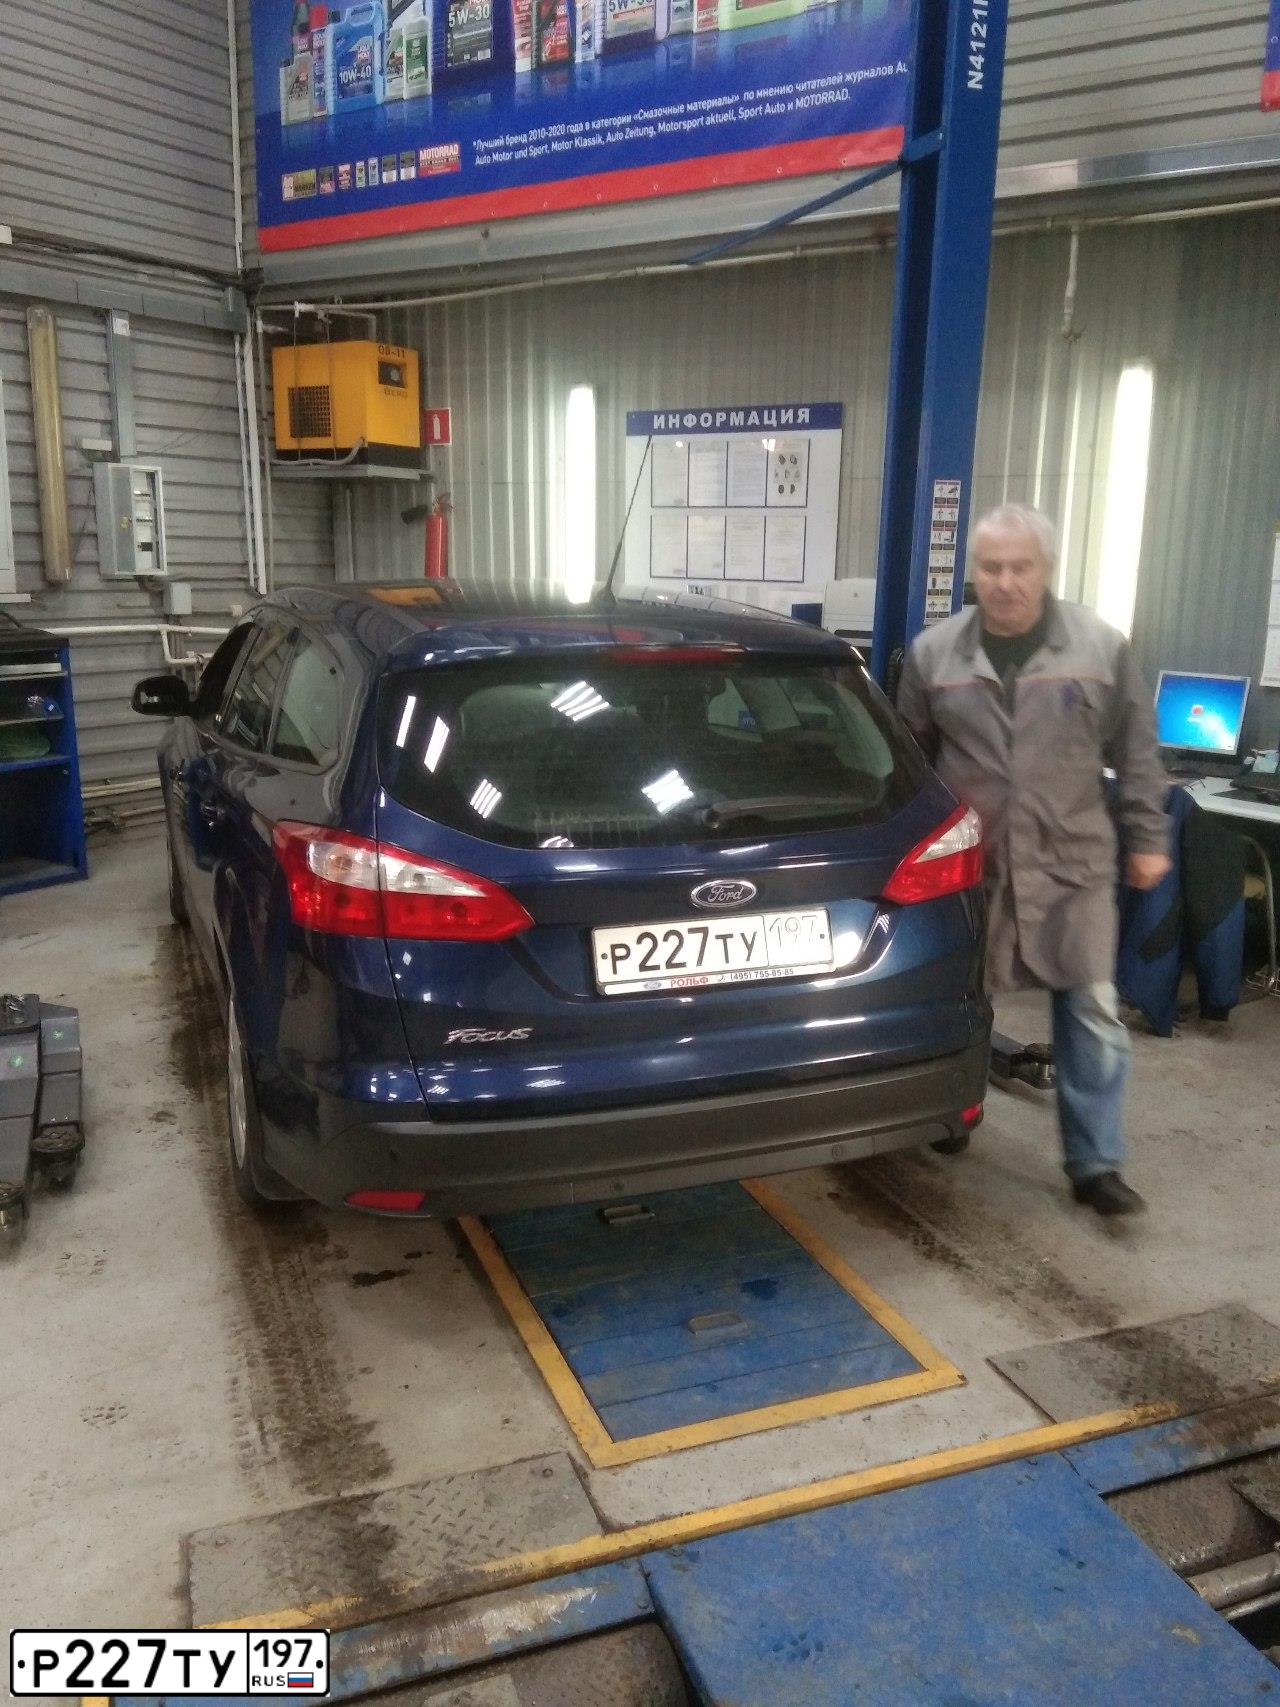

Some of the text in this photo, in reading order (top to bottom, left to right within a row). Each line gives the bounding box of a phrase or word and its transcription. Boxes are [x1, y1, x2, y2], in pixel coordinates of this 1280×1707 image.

[448, 3, 490, 28] 5W-30
[339, 65, 372, 84] 10W-40
[506, 133, 528, 147] бренд
[528, 124, 566, 140] 2010-2020
[566, 121, 584, 133] года
[591, 114, 632, 129] категории
[633, 104, 685, 121] «Смазочные
[686, 94, 740, 112] материалы»
[743, 90, 755, 101] по
[756, 83, 794, 99] мнению
[795, 73, 843, 92] читателей
[844, 64, 894, 84] журналов
[474, 154, 492, 166] Auto
[492, 150, 513, 164] Motor
[514, 147, 528, 159] und
[529, 144, 550, 158] Sport,
[551, 139, 573, 152] Motor
[574, 133, 605, 148] Klassik,
[606, 130, 624, 143] Auto
[624, 123, 657, 139] Zeitung,
[658, 116, 704, 134] Motorsport
[705, 109, 737, 126] aktuell,
[738, 104, 763, 120] Sport
[764, 102, 786, 115] Auto
[795, 88, 851, 110] MOTORRAD.
[420, 143, 459, 161] MOTORRAD
[653, 408, 811, 429] ИНФОРМАЦИЯ
[707, 883, 744, 903] Ford
[610, 915, 818, 976] Р227ТУ 197
[670, 976, 709, 988] РОЛЬФ
[730, 971, 752, 982] (495)
